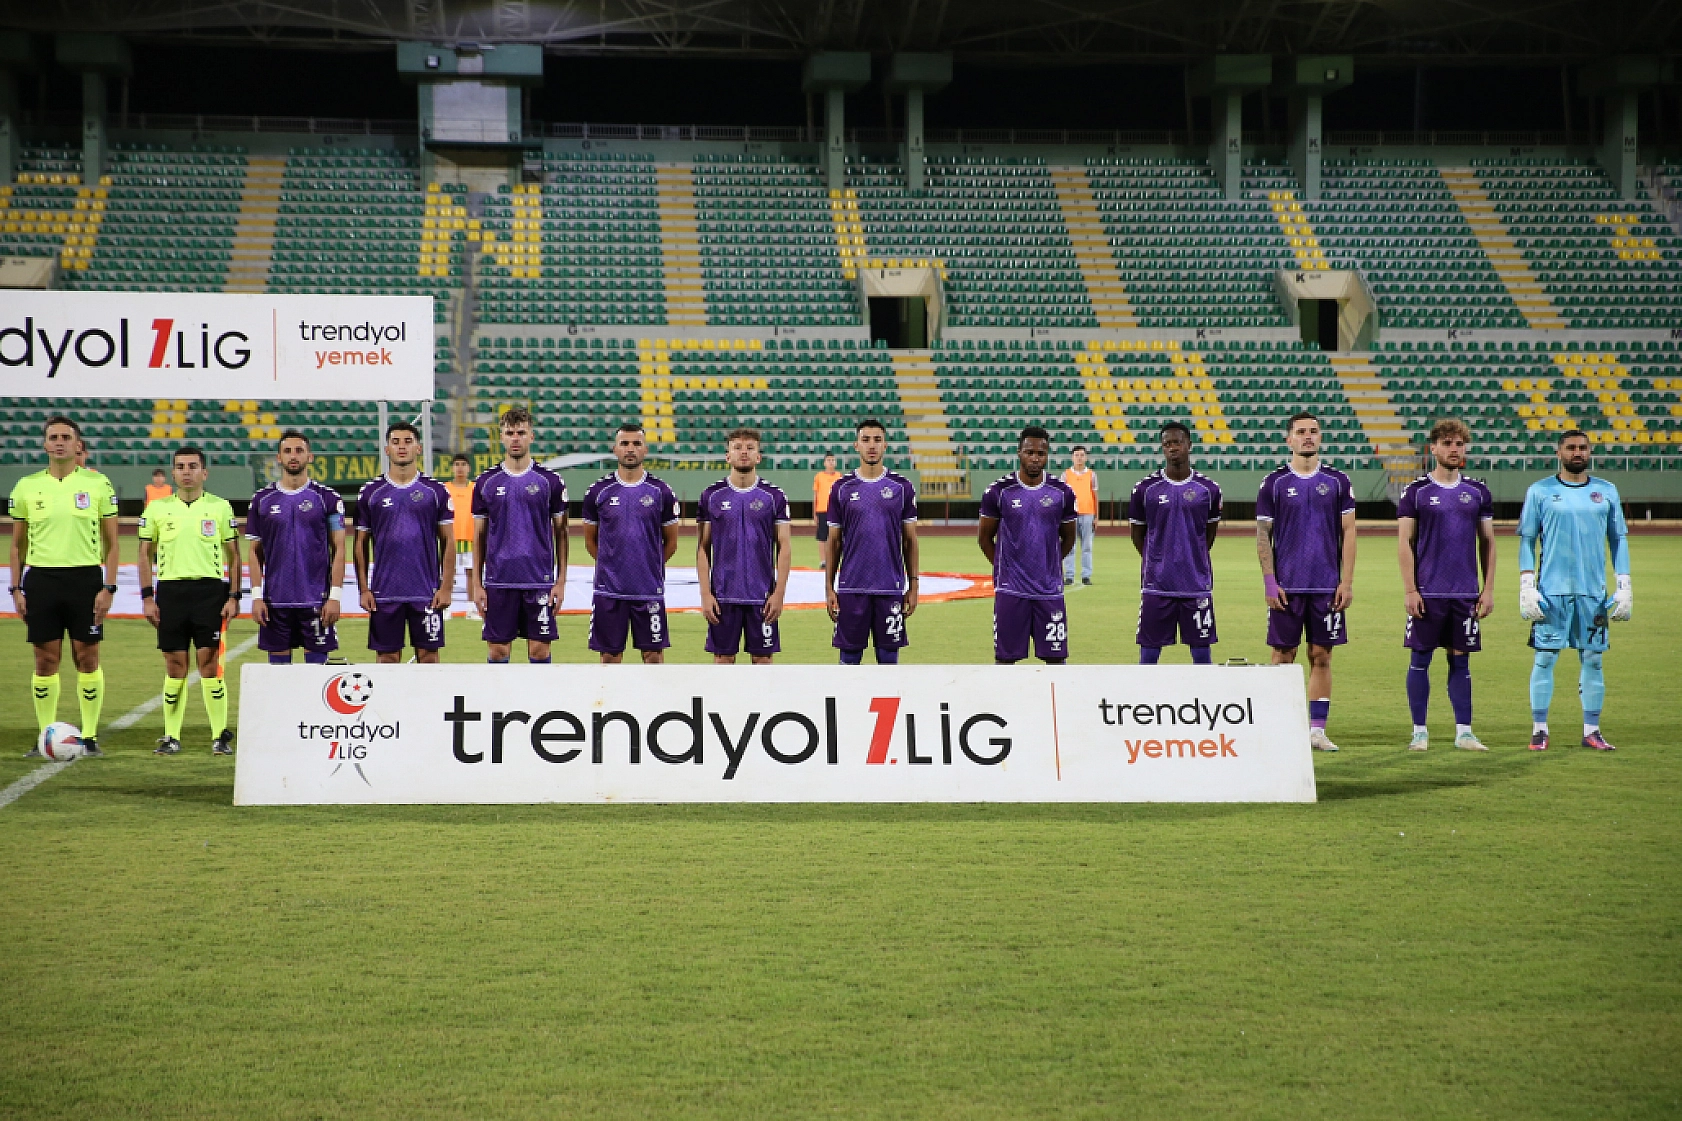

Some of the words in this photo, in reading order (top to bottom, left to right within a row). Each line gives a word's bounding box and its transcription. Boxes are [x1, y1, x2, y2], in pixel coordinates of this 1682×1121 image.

[1229, 138, 1238, 148] K
[1308, 138, 1318, 148] K
[1296, 272, 1305, 283] K
[298, 321, 406, 345] trendyol
[1196, 328, 1206, 338] K
[1447, 329, 1457, 340] K
[315, 347, 392, 370] yemek
[421, 613, 441, 635] 19
[537, 605, 550, 625] 4
[650, 614, 661, 633] 8
[1192, 609, 1213, 630] 14
[1323, 612, 1342, 632] 12
[761, 622, 773, 638] 6
[1045, 622, 1067, 642] 28
[1586, 626, 1606, 645] 71
[1098, 697, 1253, 730] trendyol
[297, 720, 400, 744] trendyol
[444, 695, 838, 780] trendyol
[1124, 733, 1237, 765] yemek
